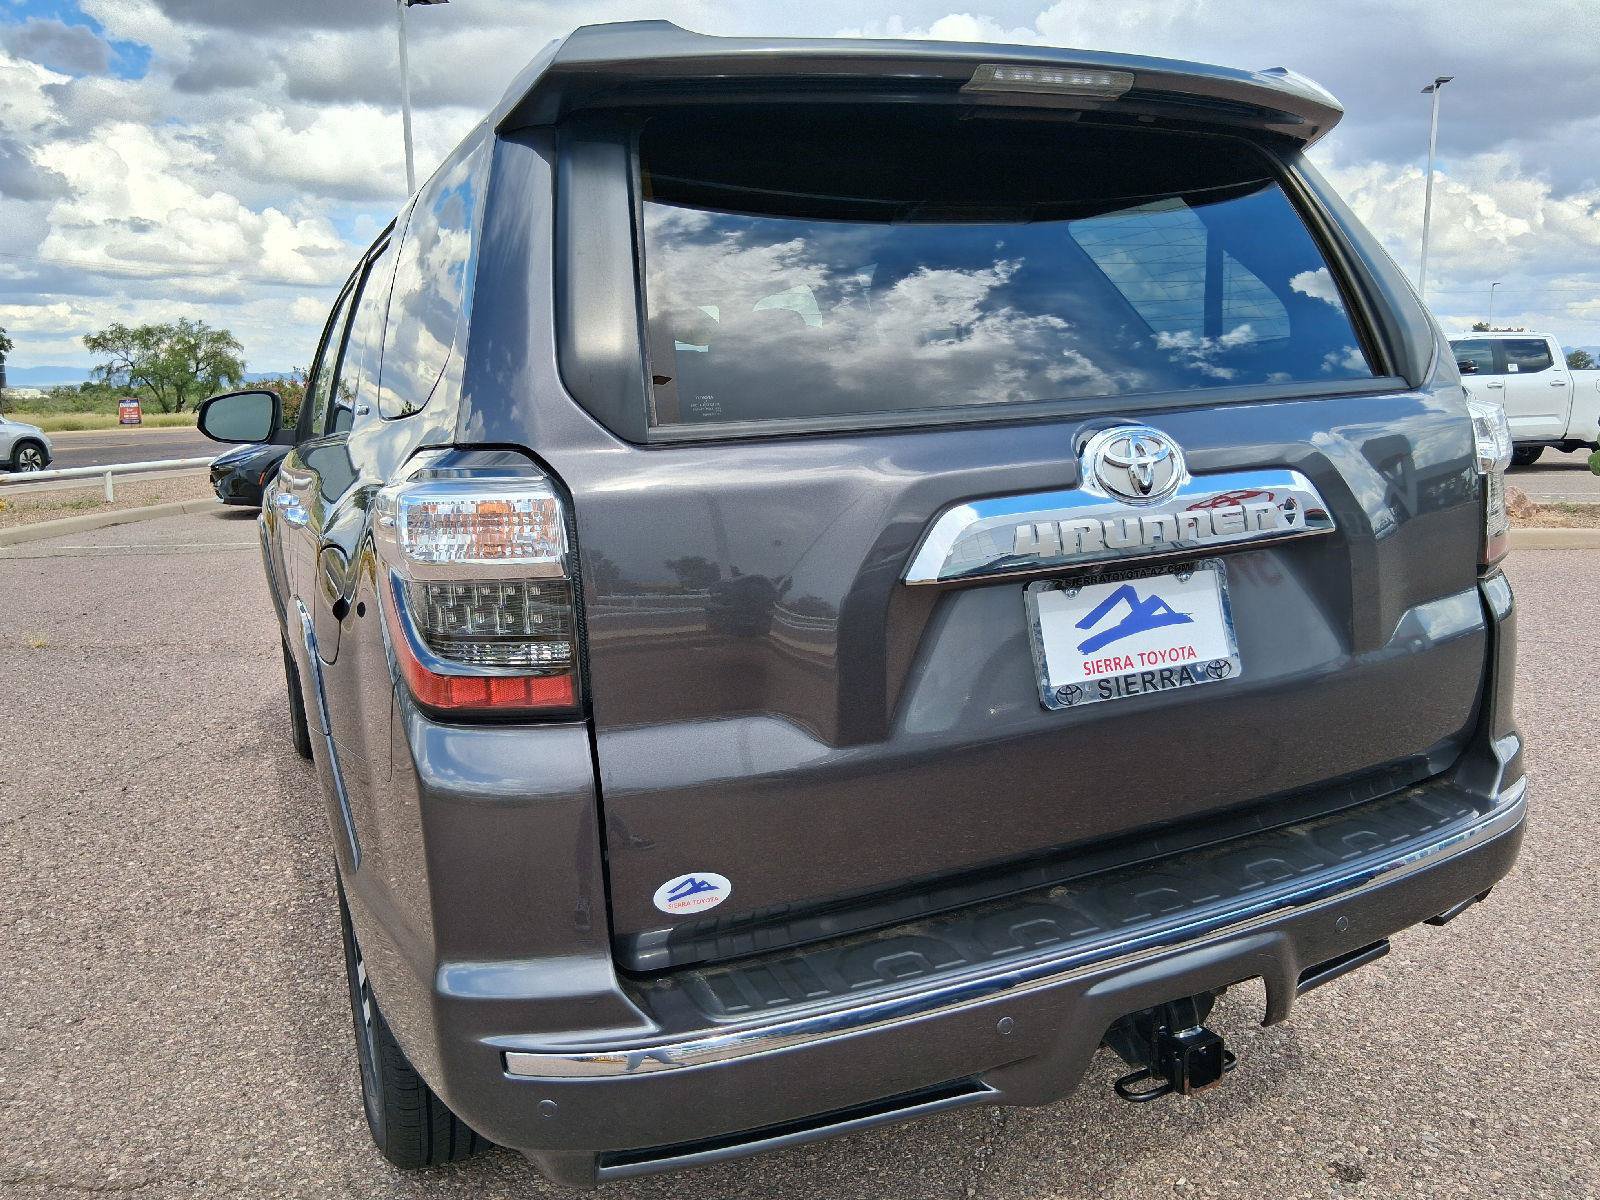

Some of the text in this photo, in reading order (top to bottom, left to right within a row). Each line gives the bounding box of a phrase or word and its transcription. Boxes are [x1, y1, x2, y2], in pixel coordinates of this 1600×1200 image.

[1083, 645, 1197, 676] SIERRA TOYOTA
[1097, 665, 1196, 700] SIERRA
[667, 900, 691, 910] SIERRA
